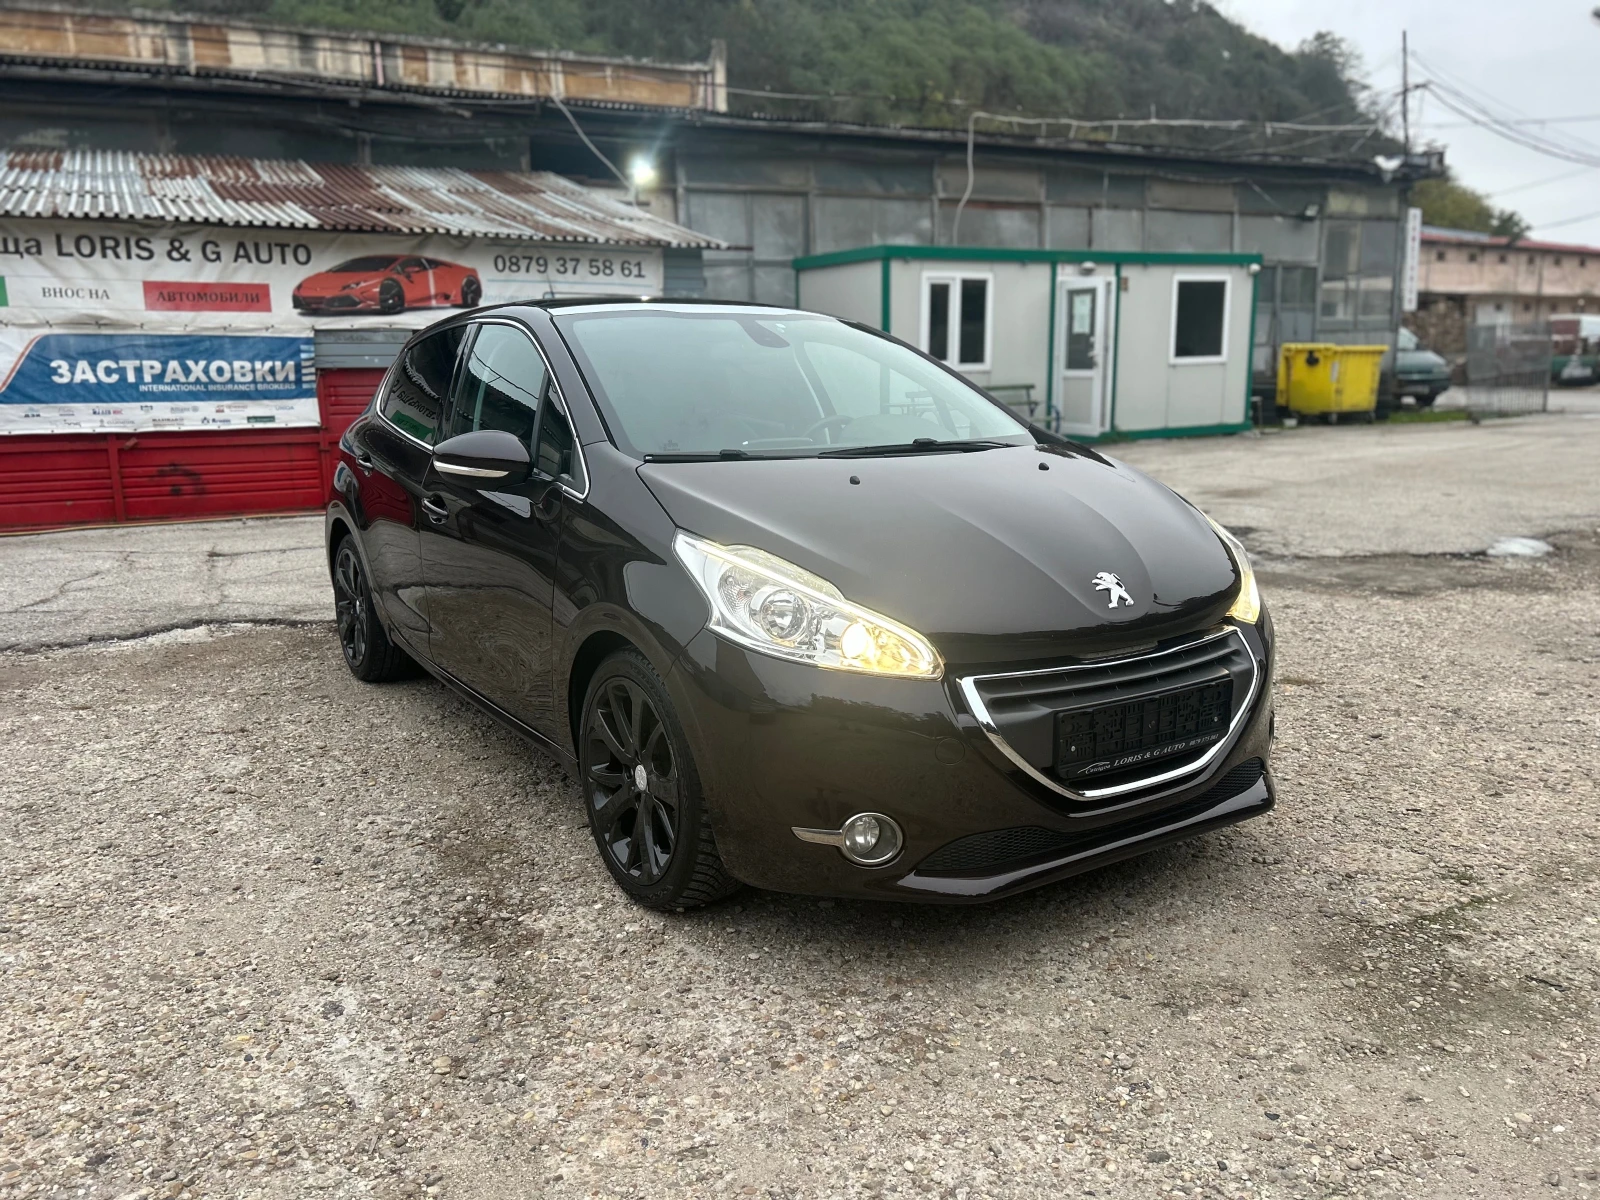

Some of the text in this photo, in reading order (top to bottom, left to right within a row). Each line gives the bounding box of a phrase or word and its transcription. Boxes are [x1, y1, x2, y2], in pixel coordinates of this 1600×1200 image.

[55, 233, 155, 261] LORIS
[166, 238, 192, 263] &
[201, 240, 222, 263] G
[233, 240, 312, 266] AUTO
[493, 254, 646, 279] 0879 37 58 61
[41, 286, 260, 303] ВНОС НА АВТОМОБИЛИ
[49, 359, 296, 384] ЗАСТРАХОВКИ
[139, 382, 297, 393] INTERNATIONAL INSURANCE BROKERS
[1113, 753, 1142, 767] LORIS
[1144, 751, 1151, 759] &
[1153, 748, 1161, 756] G
[1161, 742, 1186, 754] AUTO
